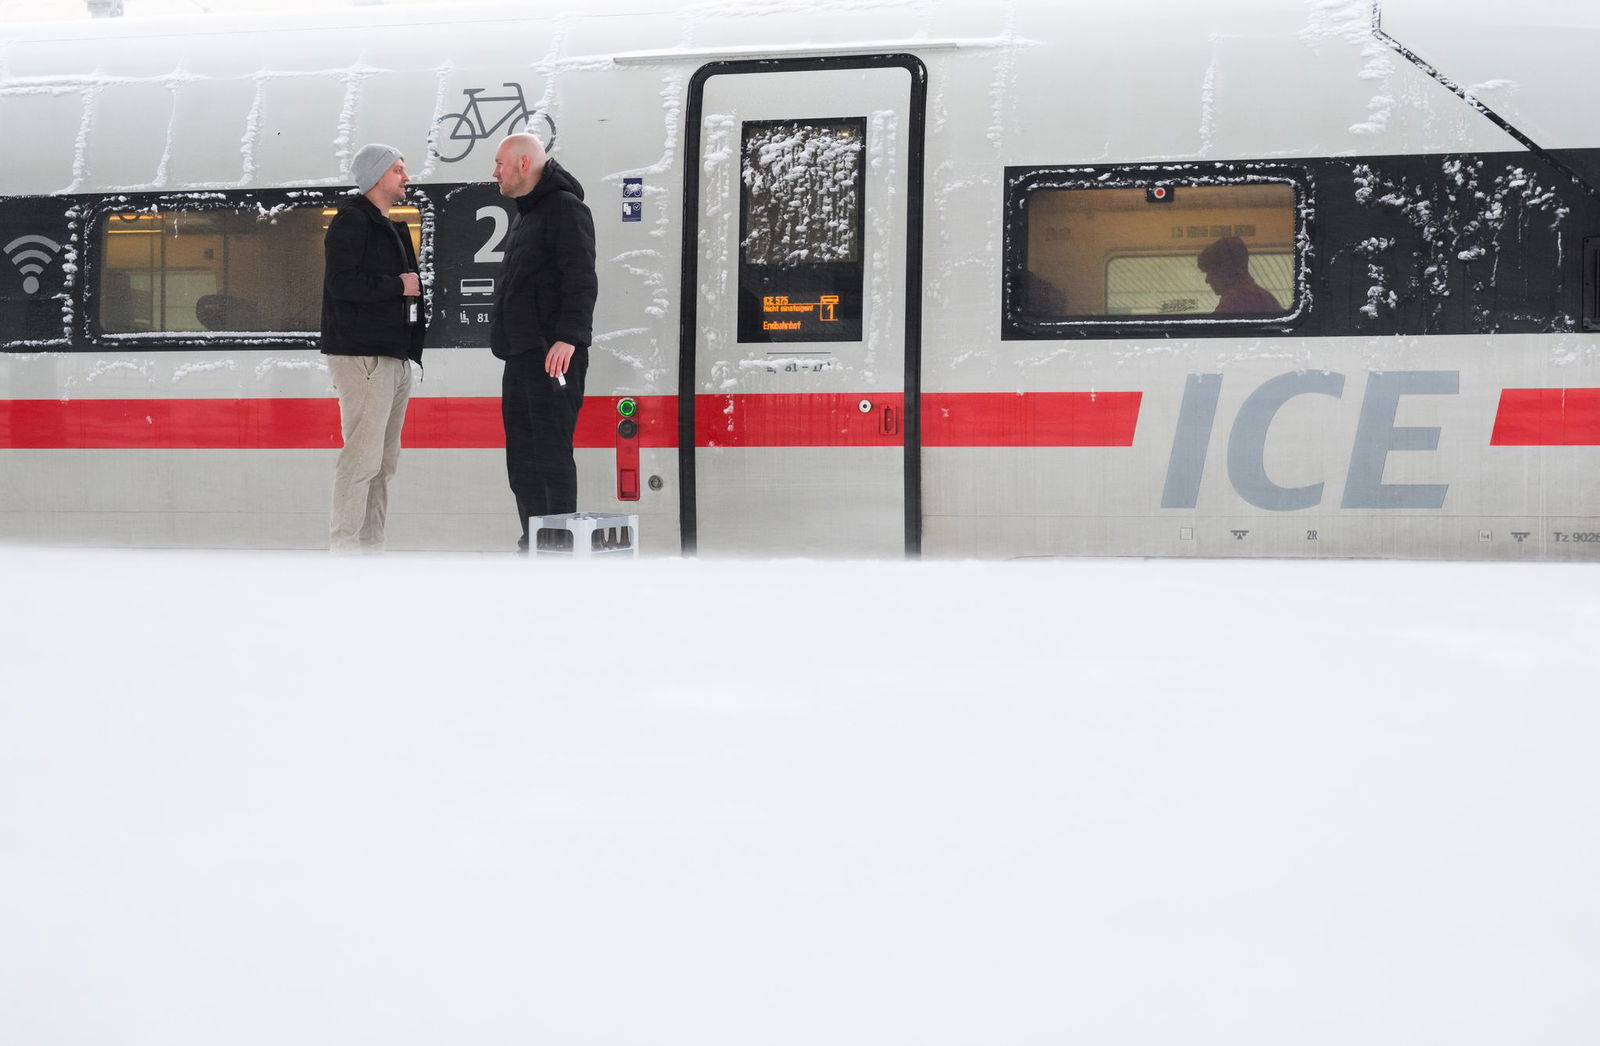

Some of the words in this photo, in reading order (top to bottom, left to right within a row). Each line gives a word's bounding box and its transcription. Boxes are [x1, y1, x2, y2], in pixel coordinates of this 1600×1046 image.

[474, 205, 509, 263] 2
[763, 296, 774, 305] ICE
[775, 296, 789, 305] 575
[827, 304, 834, 320] 1
[477, 313, 489, 323] 81
[763, 321, 801, 330] Endbahnhof
[1160, 369, 1460, 512] ICE
[1307, 530, 1318, 540] 2R
[1553, 532, 1569, 542] Tz
